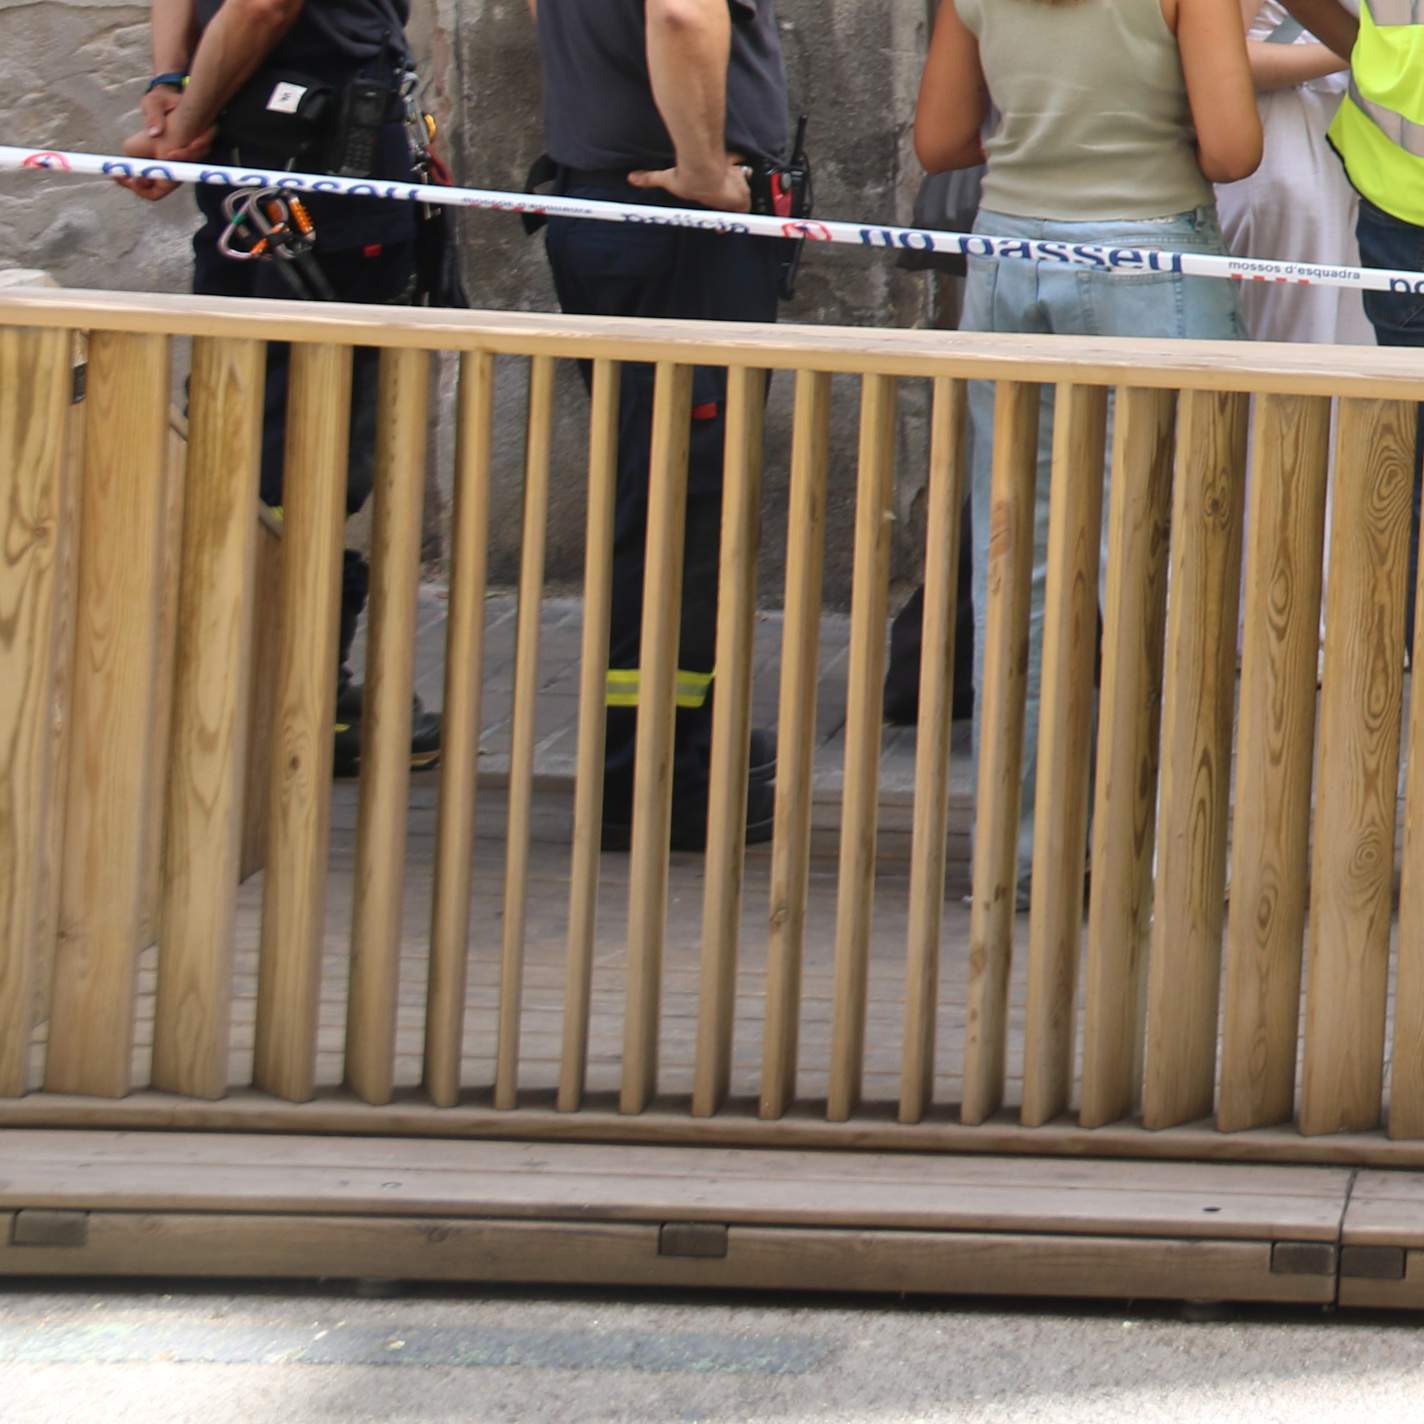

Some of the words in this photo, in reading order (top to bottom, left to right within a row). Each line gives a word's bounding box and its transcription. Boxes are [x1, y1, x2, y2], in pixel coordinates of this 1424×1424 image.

[859, 228, 935, 252] no
[1228, 259, 1281, 274] mossos
[1285, 265, 1361, 280] d'esquadra
